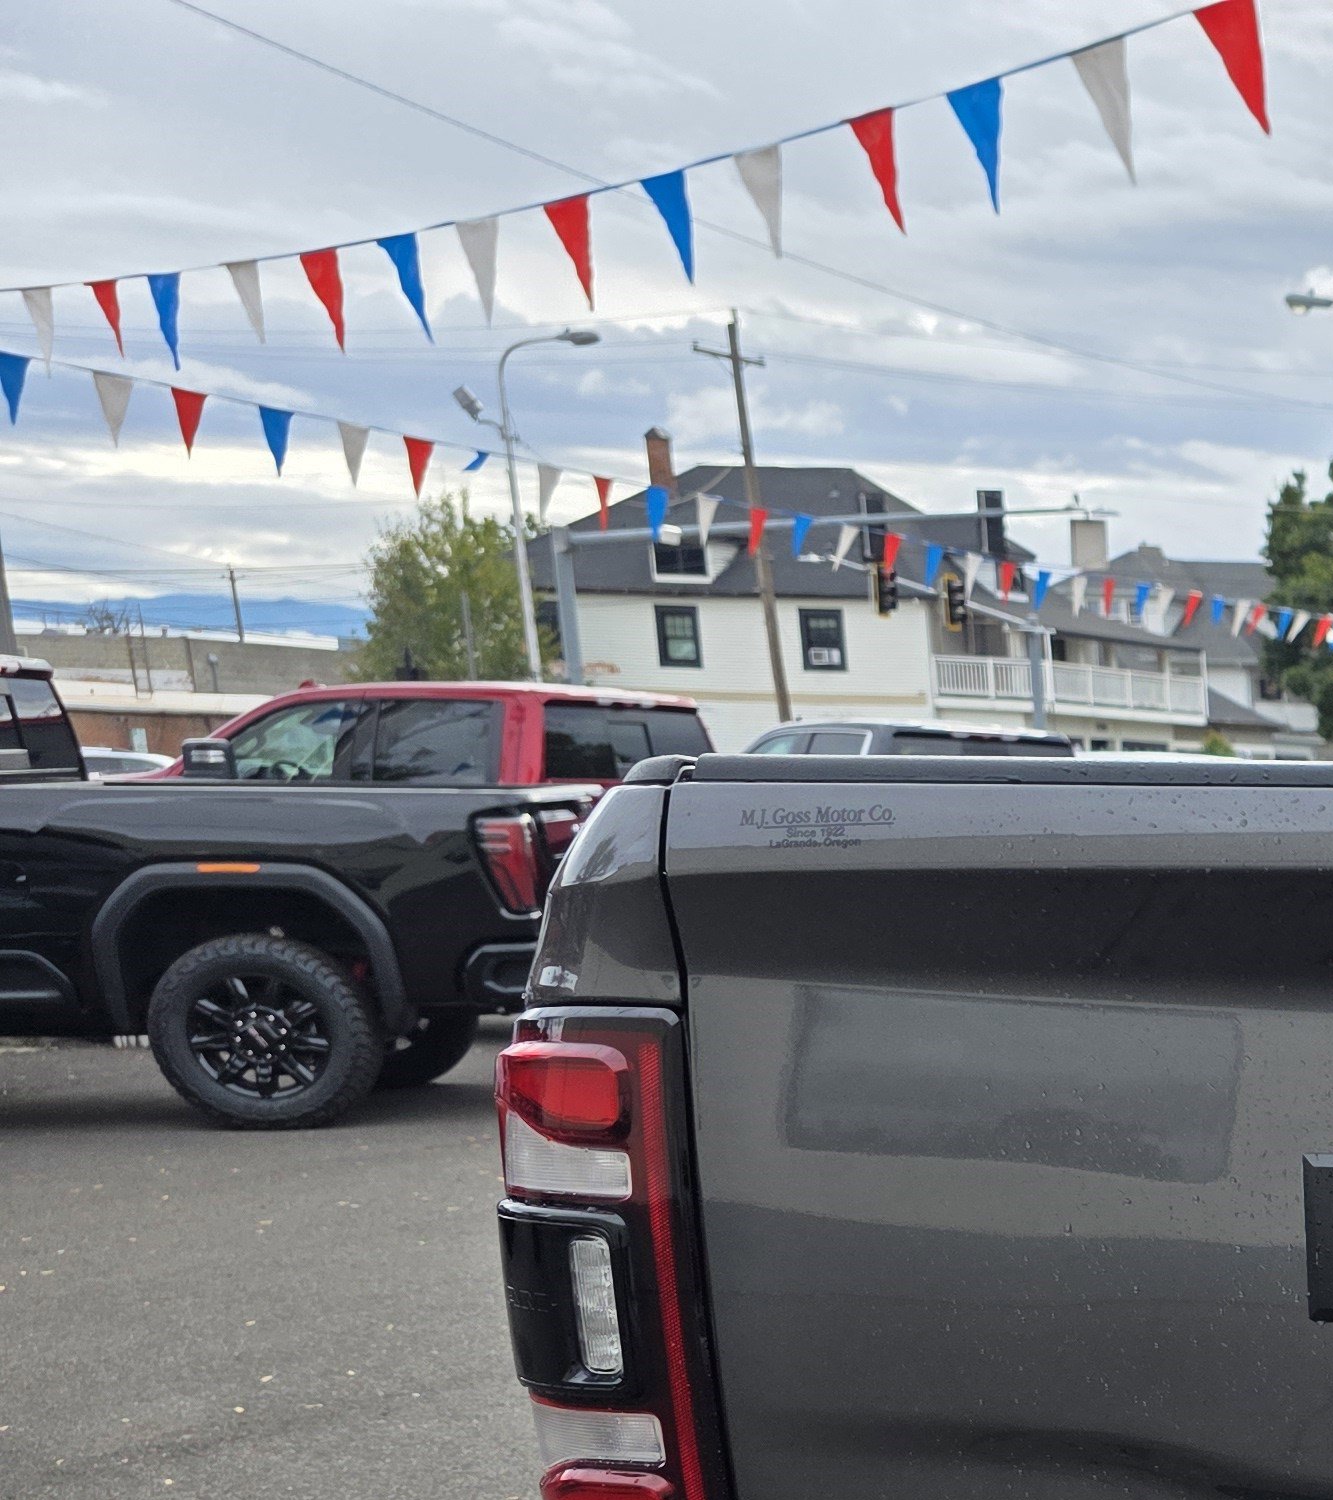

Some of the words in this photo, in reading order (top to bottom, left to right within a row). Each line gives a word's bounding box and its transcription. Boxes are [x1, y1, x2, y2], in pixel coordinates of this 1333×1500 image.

[740, 808, 769, 829] M.J.
[772, 807, 811, 825] Goss
[815, 806, 865, 824] Motor
[868, 804, 897, 822] Co.
[786, 827, 817, 839] Since
[820, 825, 846, 838] 1922
[823, 837, 861, 849] Oregon
